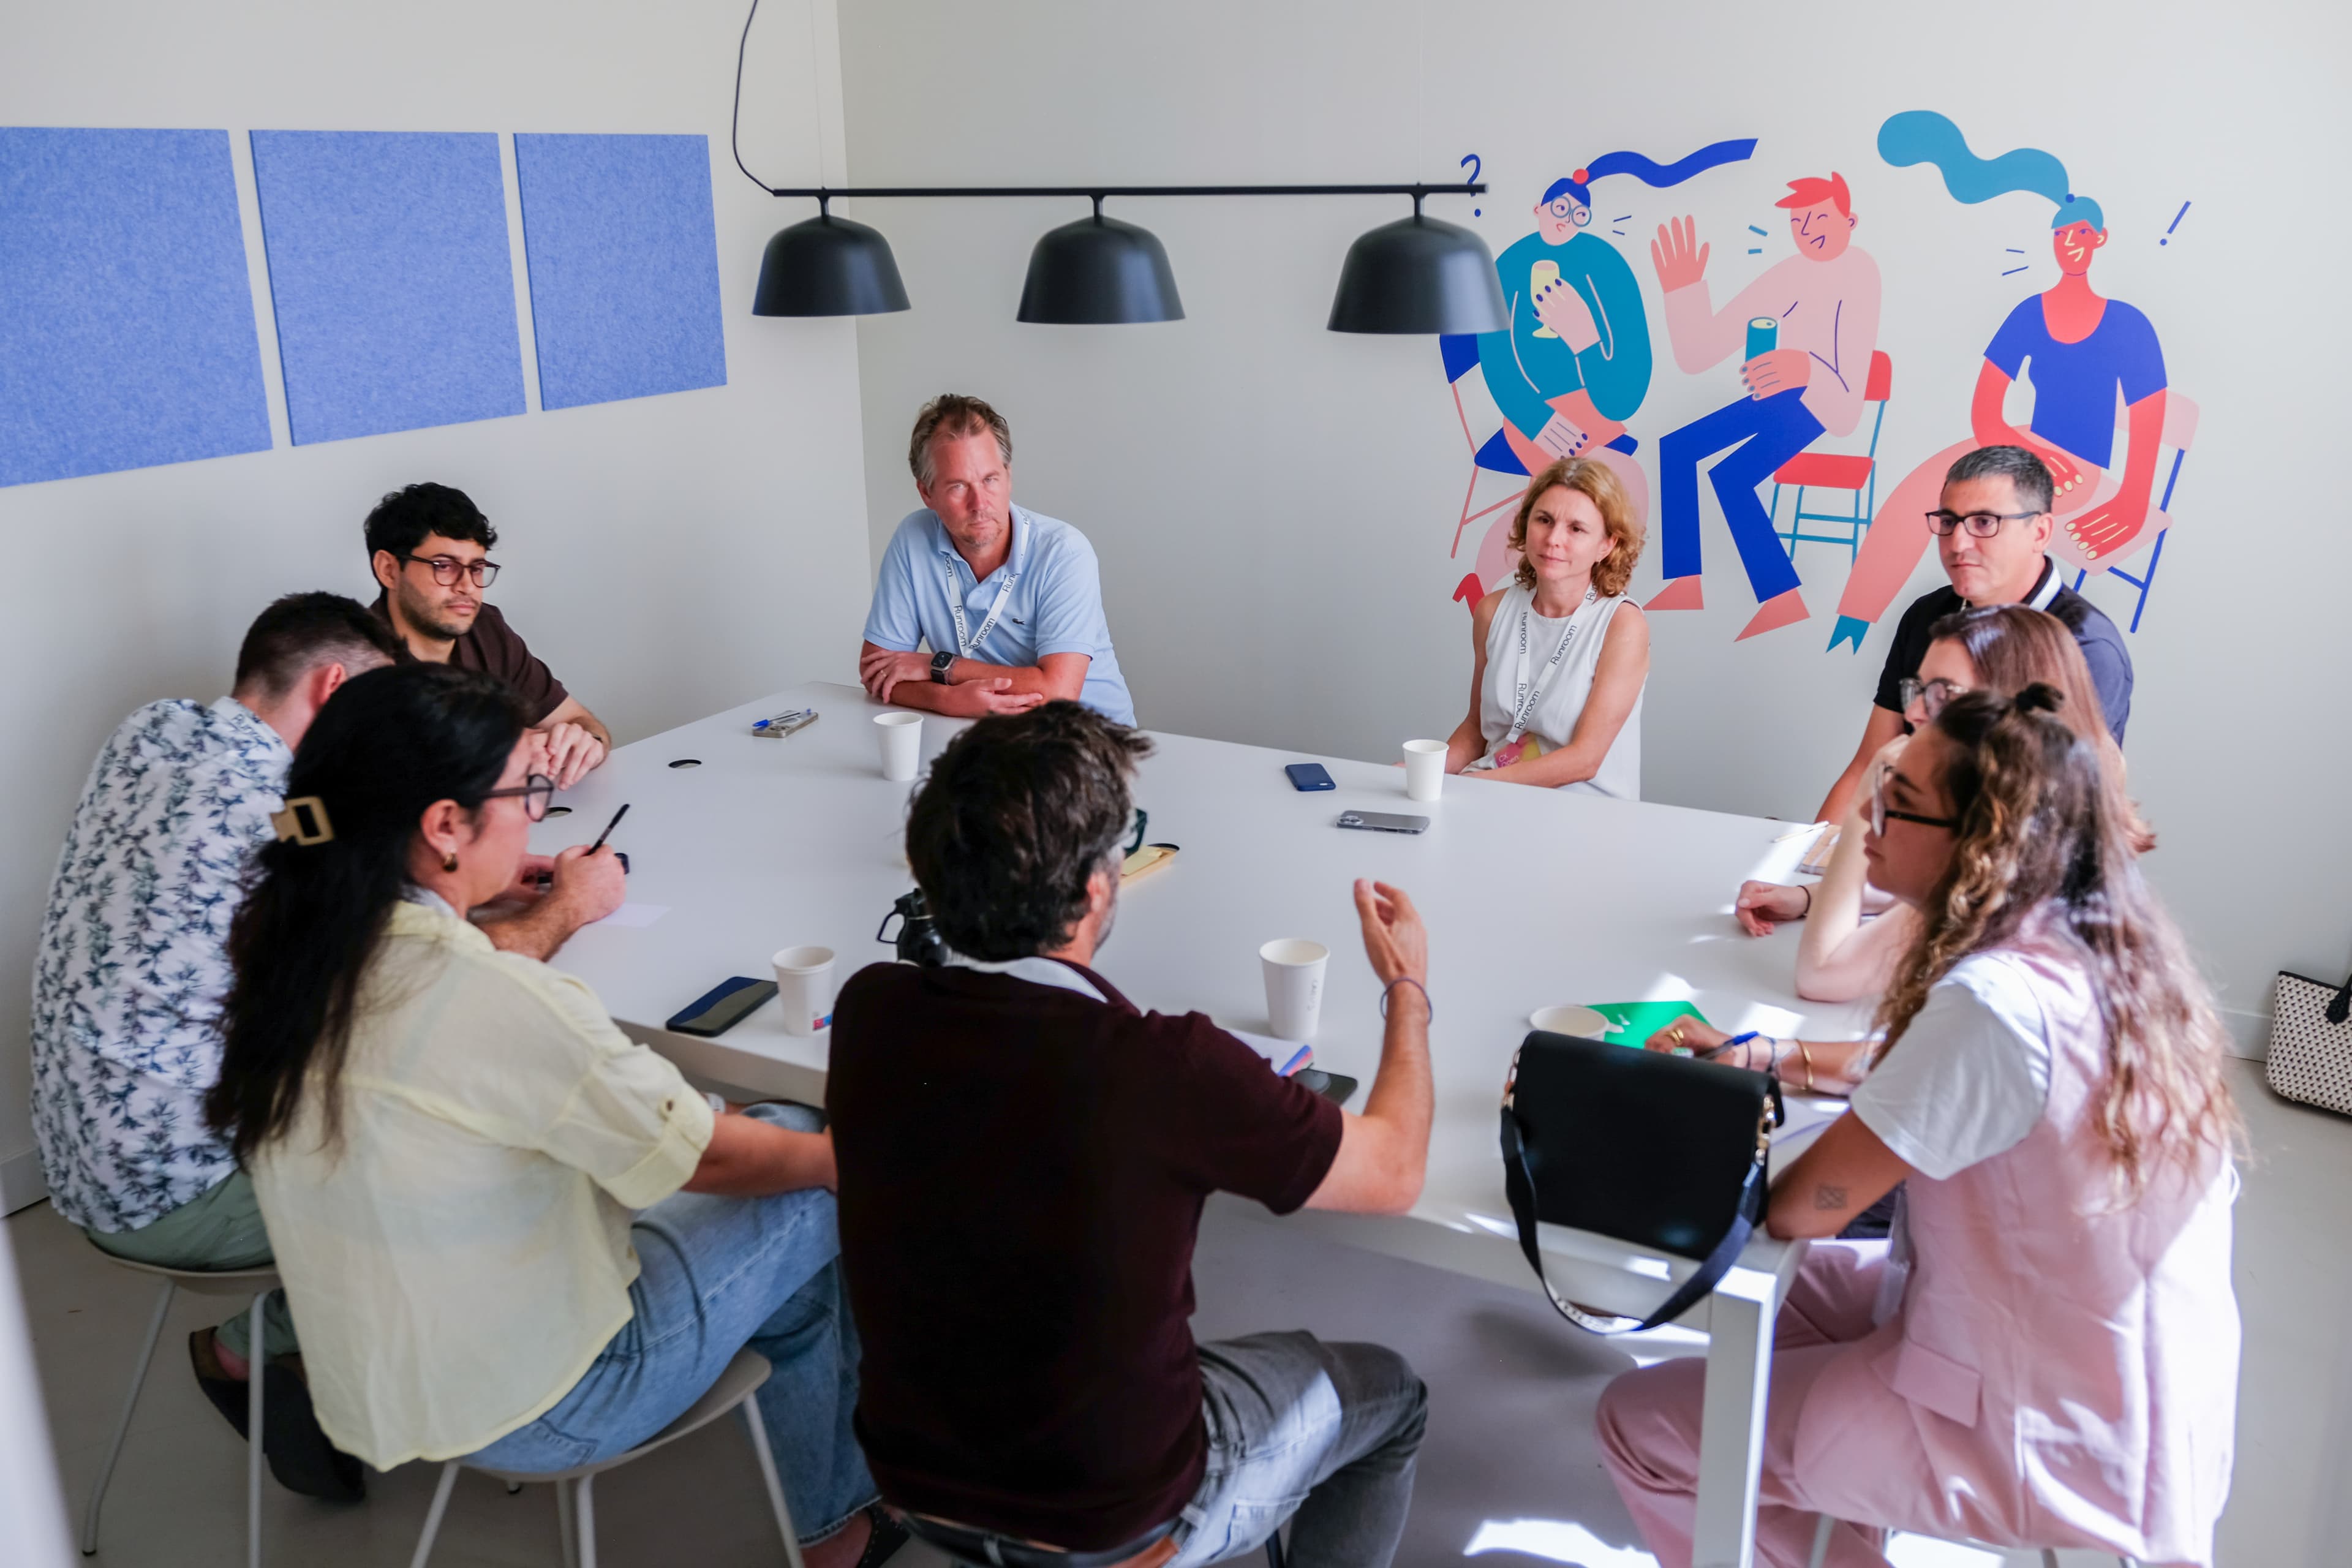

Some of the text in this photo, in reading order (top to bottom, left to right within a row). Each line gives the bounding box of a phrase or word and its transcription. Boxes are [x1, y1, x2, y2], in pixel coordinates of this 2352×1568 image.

[954, 605, 967, 647] Runroom
[969, 617, 995, 650] Runroom
[1550, 625, 1577, 665] Runroom
[1514, 690, 1540, 730] Runroom
